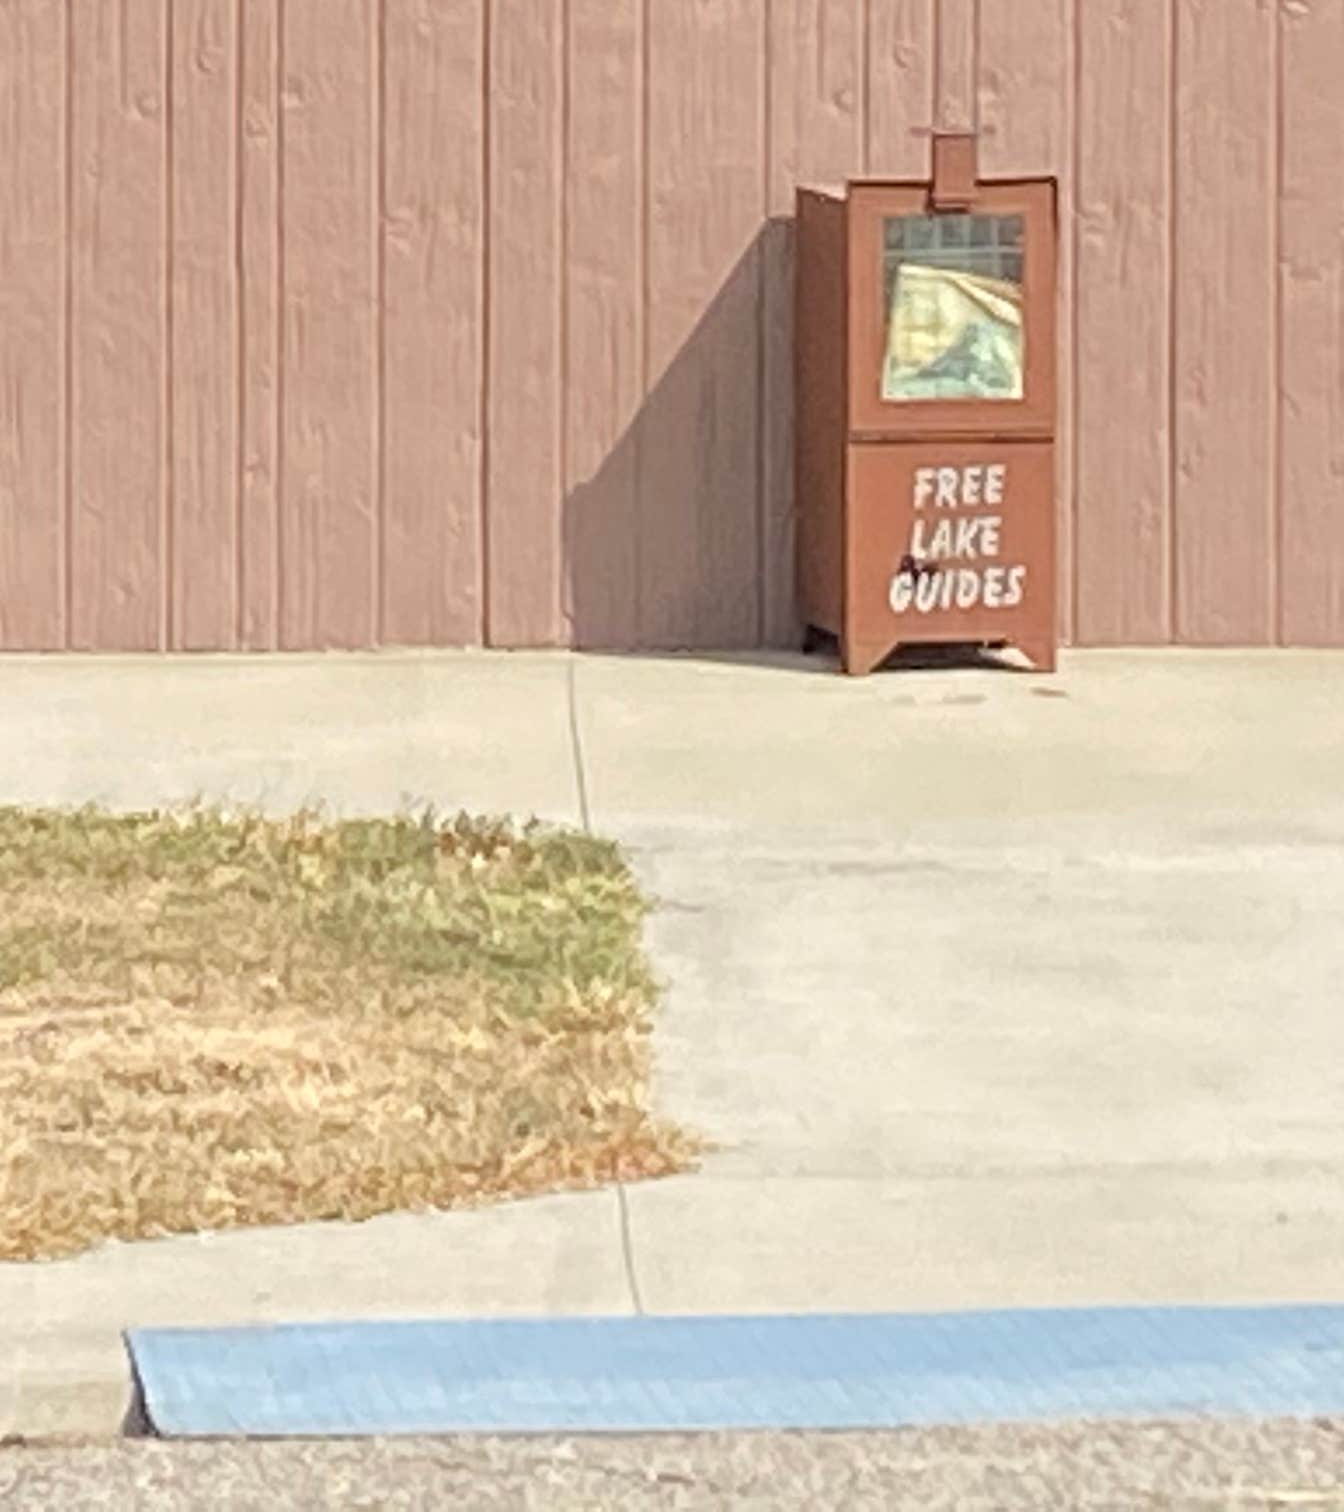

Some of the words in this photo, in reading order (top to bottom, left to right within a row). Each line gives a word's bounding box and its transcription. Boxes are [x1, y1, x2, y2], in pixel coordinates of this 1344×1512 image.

[913, 463, 1006, 509] FREE
[910, 515, 1002, 560] LAKE
[889, 564, 1027, 613] GUIDES
